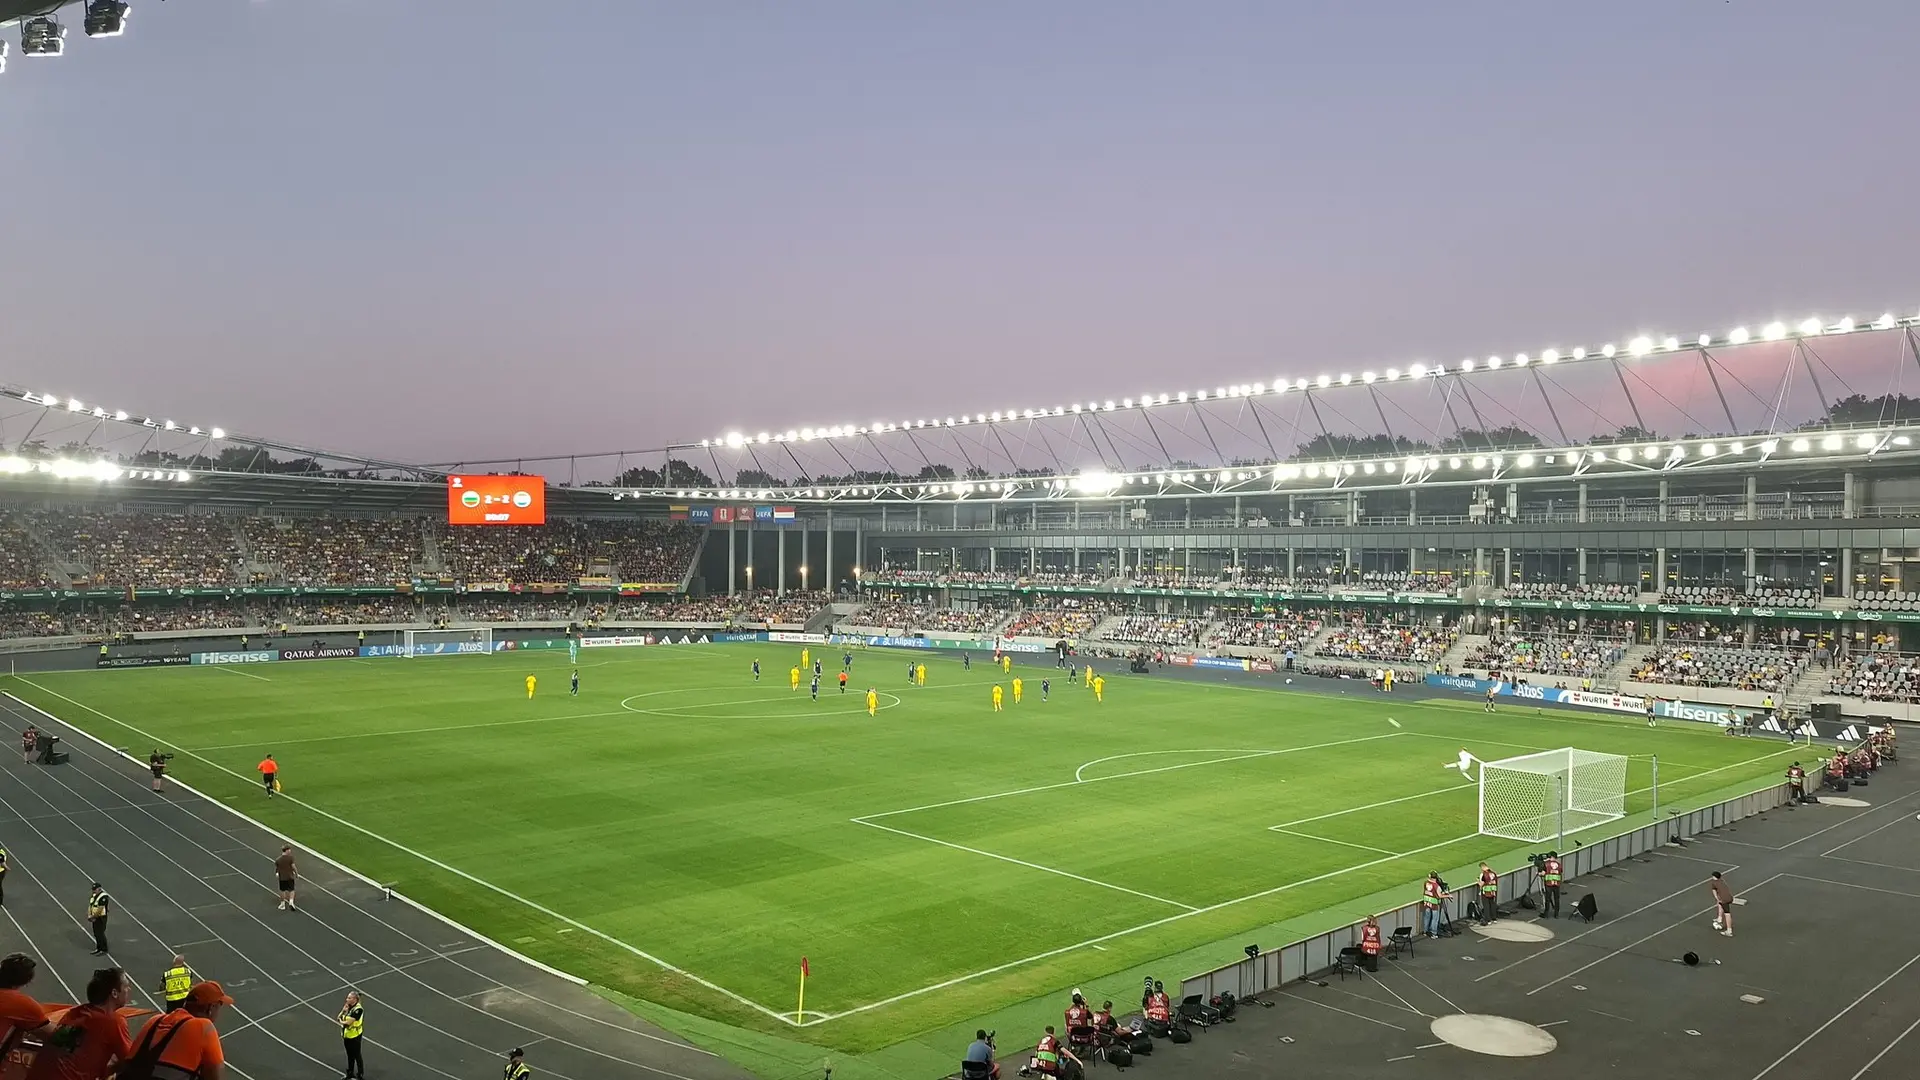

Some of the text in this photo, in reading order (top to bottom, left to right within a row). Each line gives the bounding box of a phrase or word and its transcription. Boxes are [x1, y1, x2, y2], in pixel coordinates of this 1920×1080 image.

[993, 641, 1039, 653] Hisense
[201, 652, 269, 663] Hisense
[284, 648, 354, 659] QATAR AIRWAYS
[1664, 701, 1742, 727] Hisense
